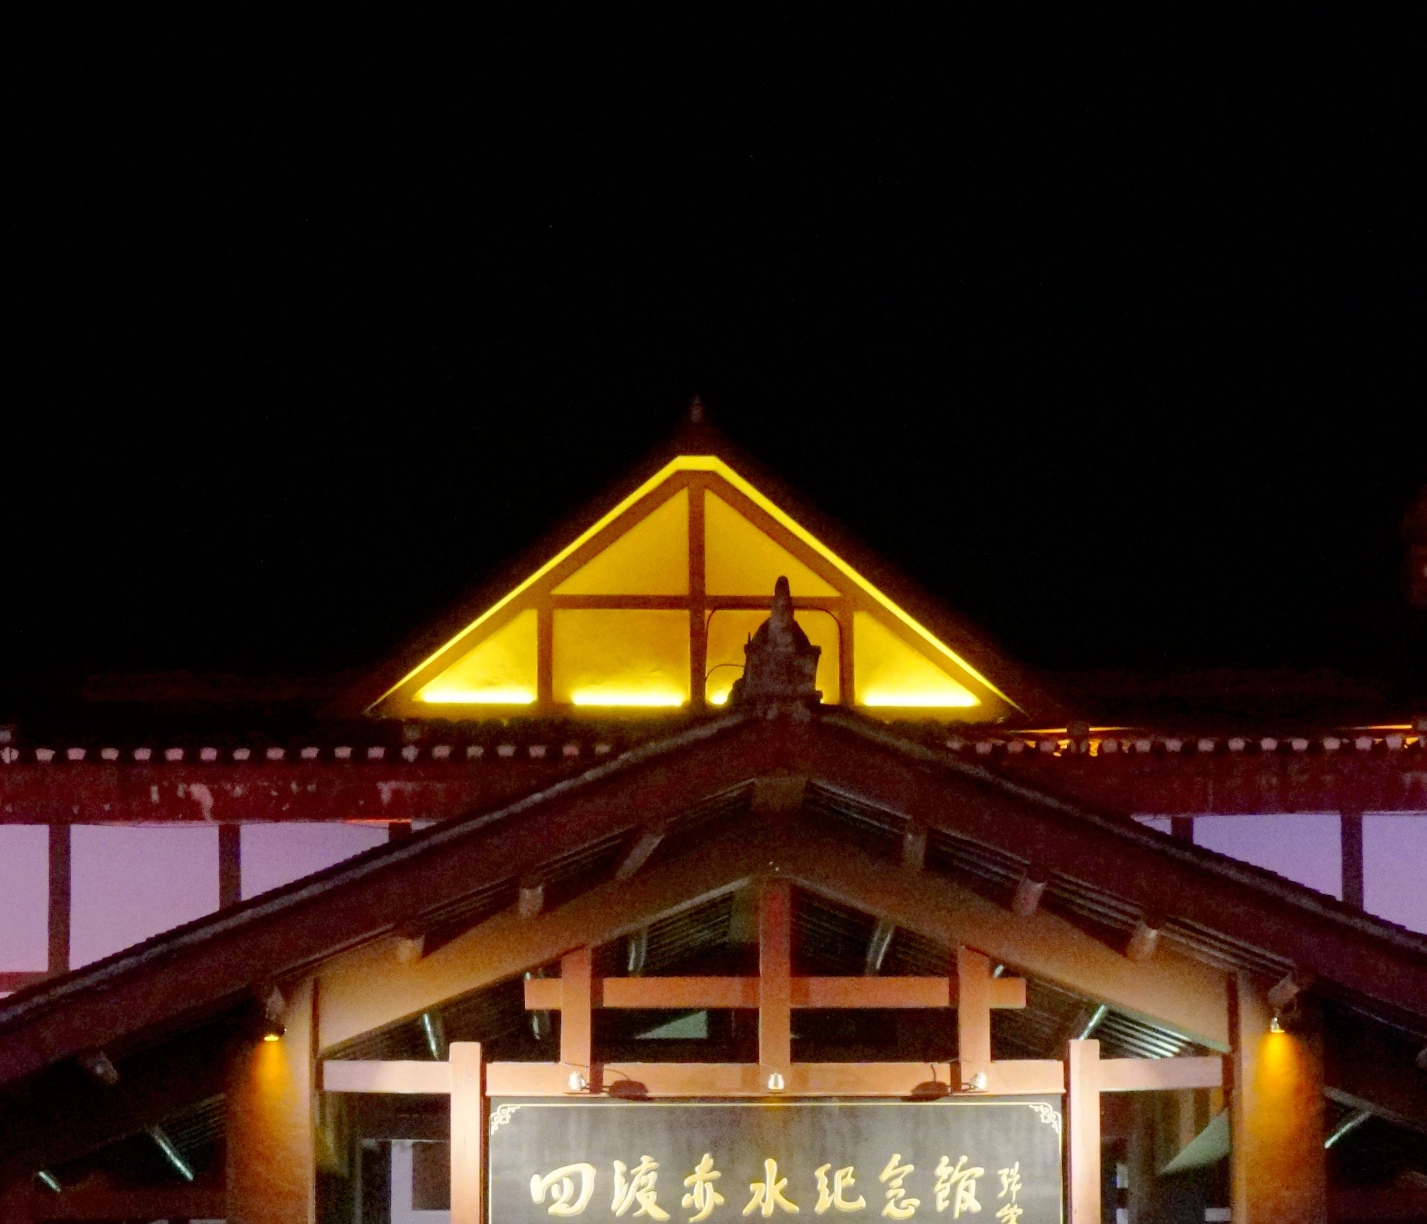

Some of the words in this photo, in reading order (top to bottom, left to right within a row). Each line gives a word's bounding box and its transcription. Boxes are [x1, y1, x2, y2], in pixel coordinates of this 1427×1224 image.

[529, 1152, 985, 1224] 四渡赤水纪念馆
